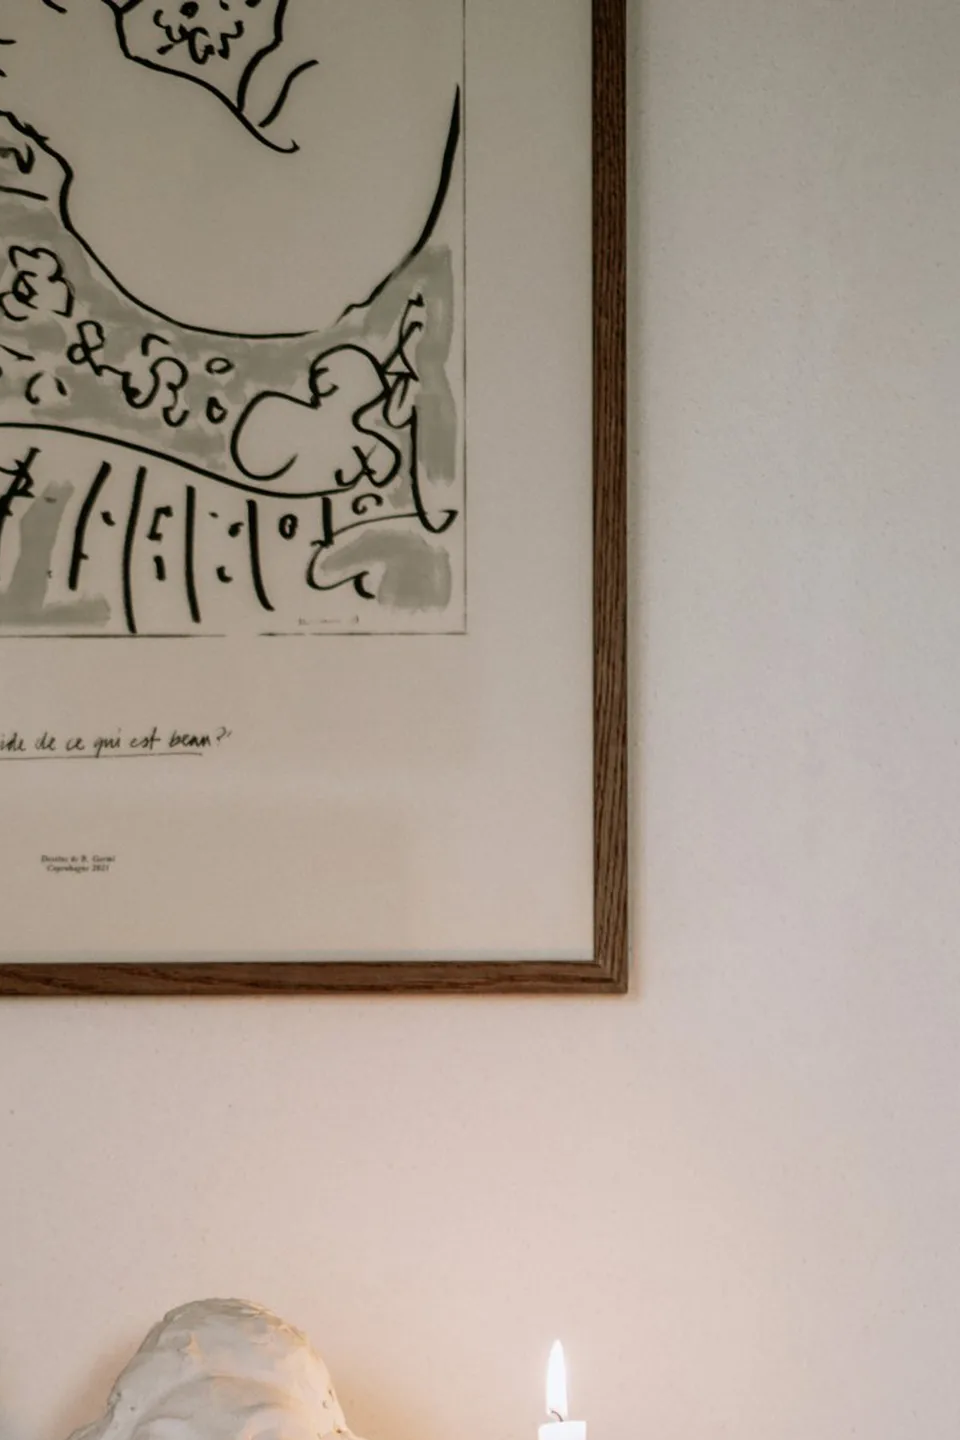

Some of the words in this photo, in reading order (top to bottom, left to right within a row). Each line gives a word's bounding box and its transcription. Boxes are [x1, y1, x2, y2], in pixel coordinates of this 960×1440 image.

[36, 732, 56, 751] de
[66, 737, 85, 751] ce
[93, 727, 121, 759] qui
[129, 726, 160, 750] est
